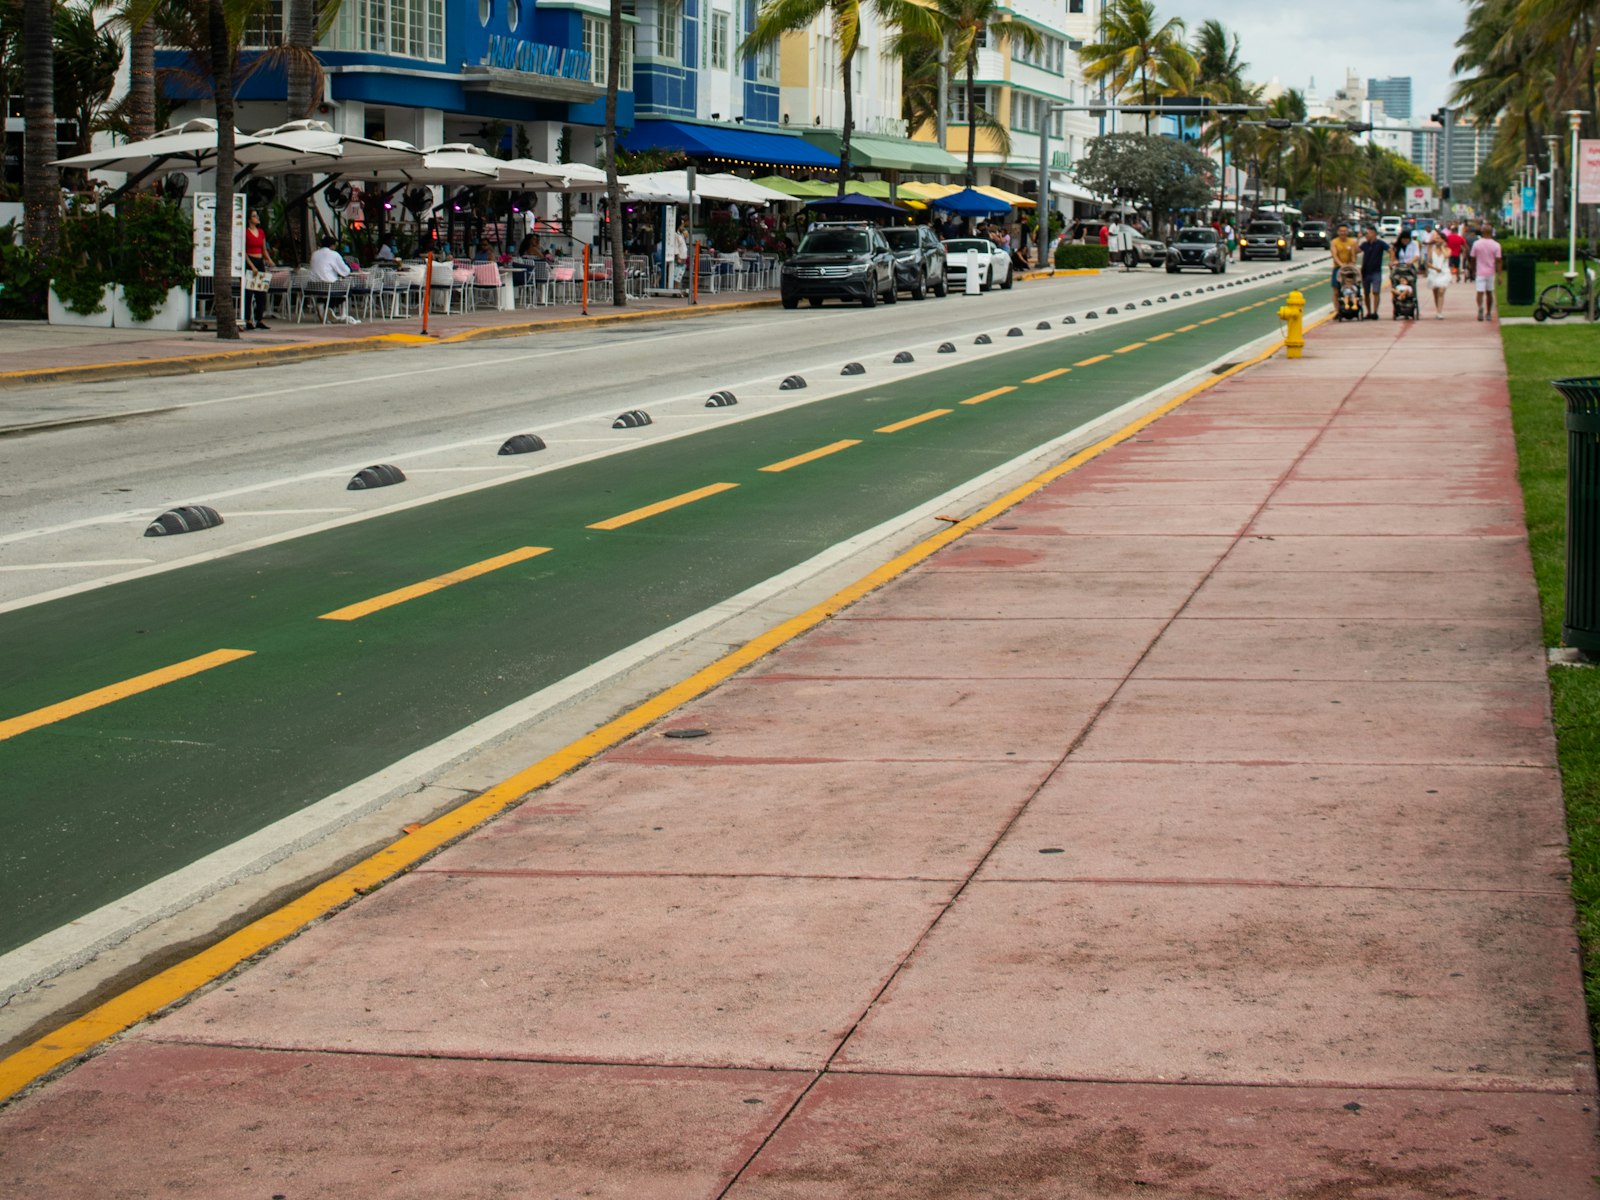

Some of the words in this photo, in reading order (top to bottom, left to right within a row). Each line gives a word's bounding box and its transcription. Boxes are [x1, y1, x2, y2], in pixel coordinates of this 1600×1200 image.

[487, 34, 516, 68] PARK
[515, 40, 560, 77] CENTRAL
[560, 48, 592, 80] HOTEL
